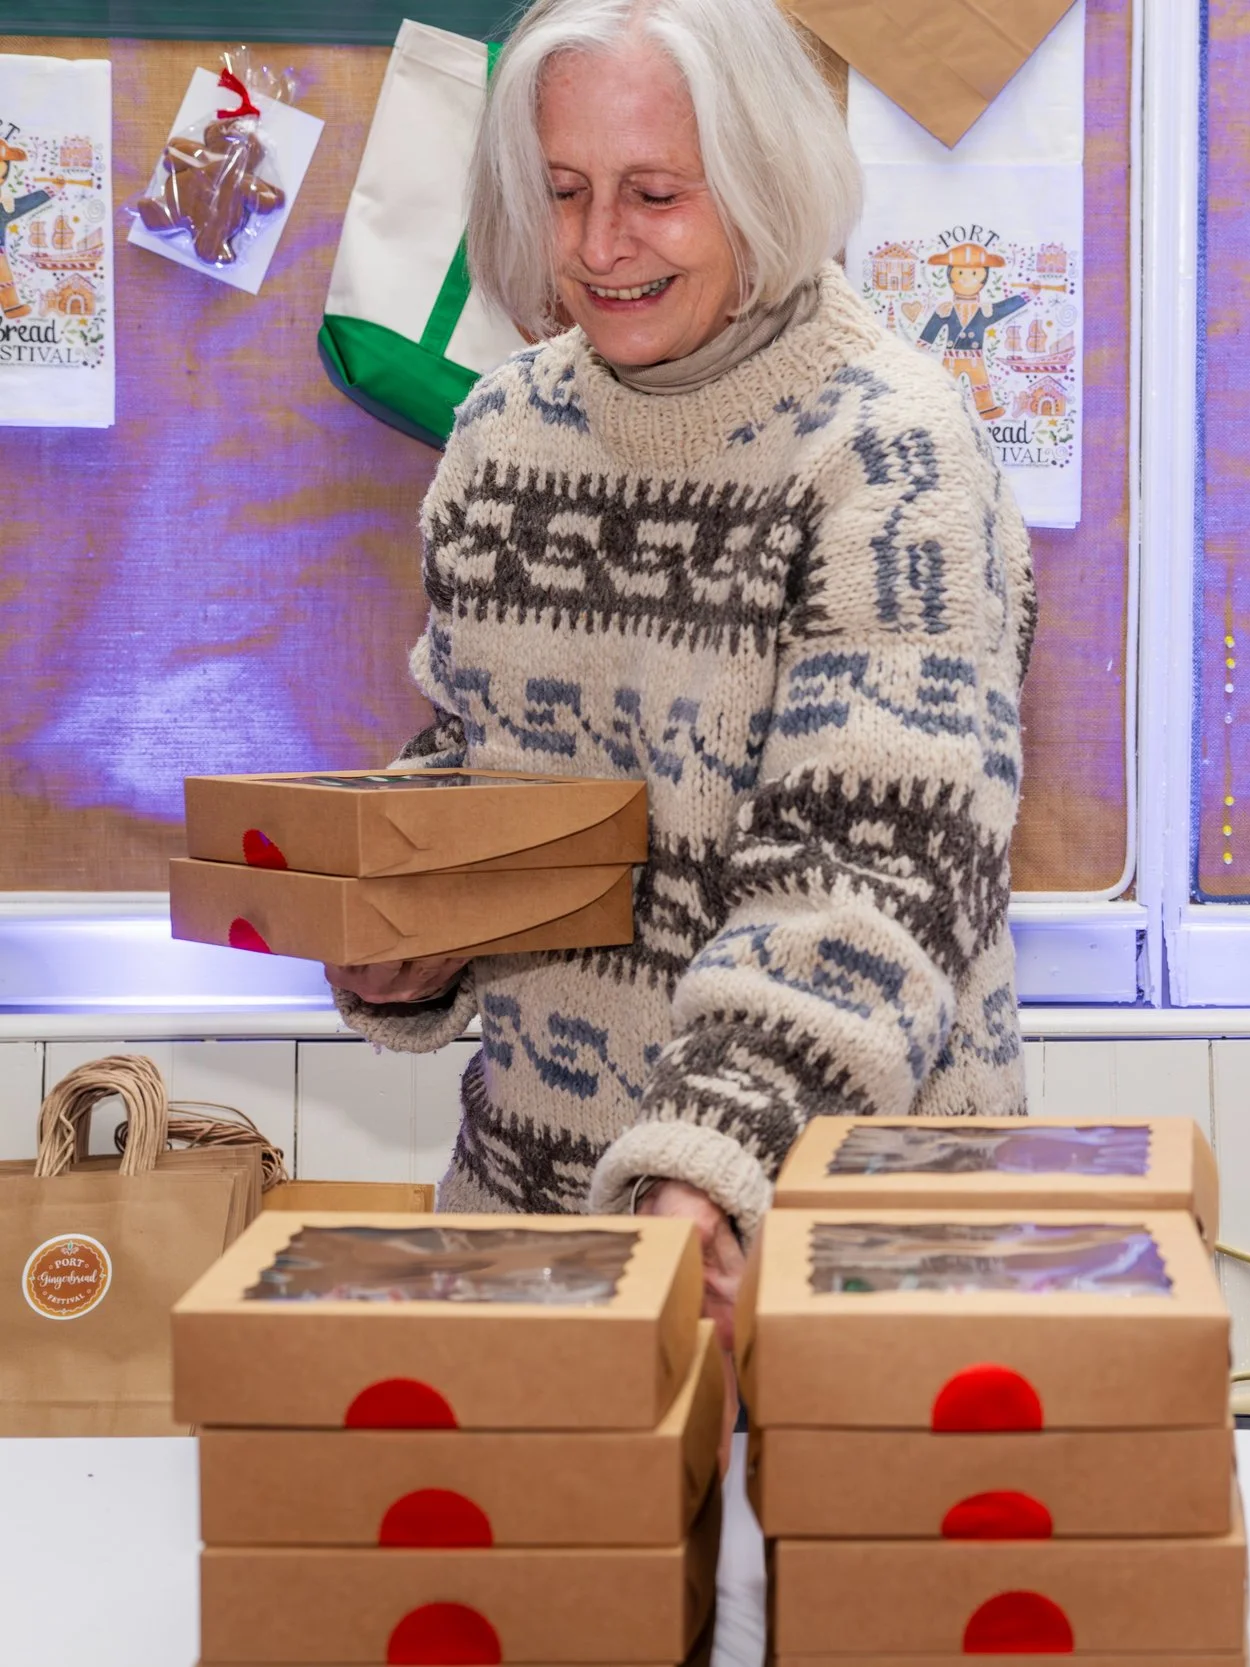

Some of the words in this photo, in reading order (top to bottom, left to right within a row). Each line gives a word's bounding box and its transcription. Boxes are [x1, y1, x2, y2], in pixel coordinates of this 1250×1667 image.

[939, 224, 1000, 248] PORT
[55, 1257, 85, 1269] PORT
[37, 1269, 98, 1290] Gingerbread
[47, 1293, 86, 1305] FESTIVAL
